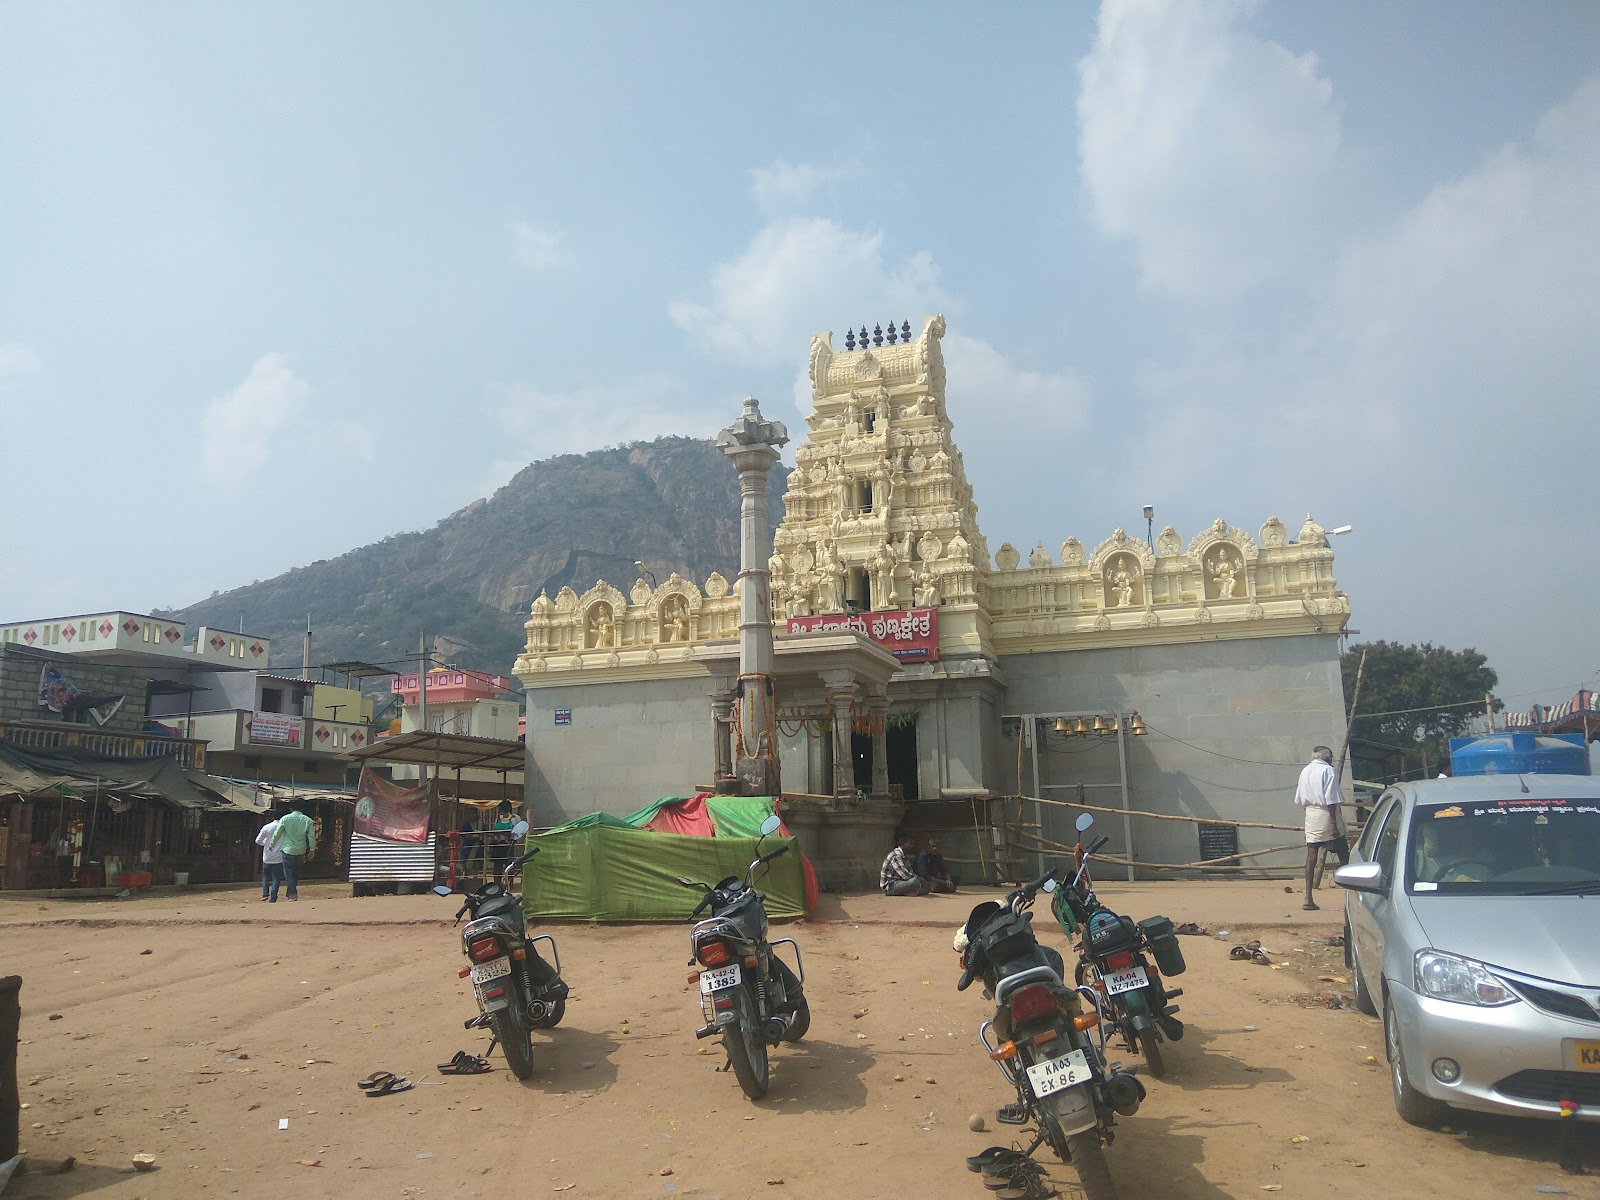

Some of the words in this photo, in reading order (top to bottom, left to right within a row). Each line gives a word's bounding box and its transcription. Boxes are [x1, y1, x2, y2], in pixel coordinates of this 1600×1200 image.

[872, 611, 930, 641] ಪುಣ್ಯಕ್ಷೇತ್ರ
[707, 975, 736, 990] 1385
[1111, 978, 1145, 992] HZ-7475
[1112, 972, 1137, 984] KA-04
[1045, 1057, 1071, 1075] KA03
